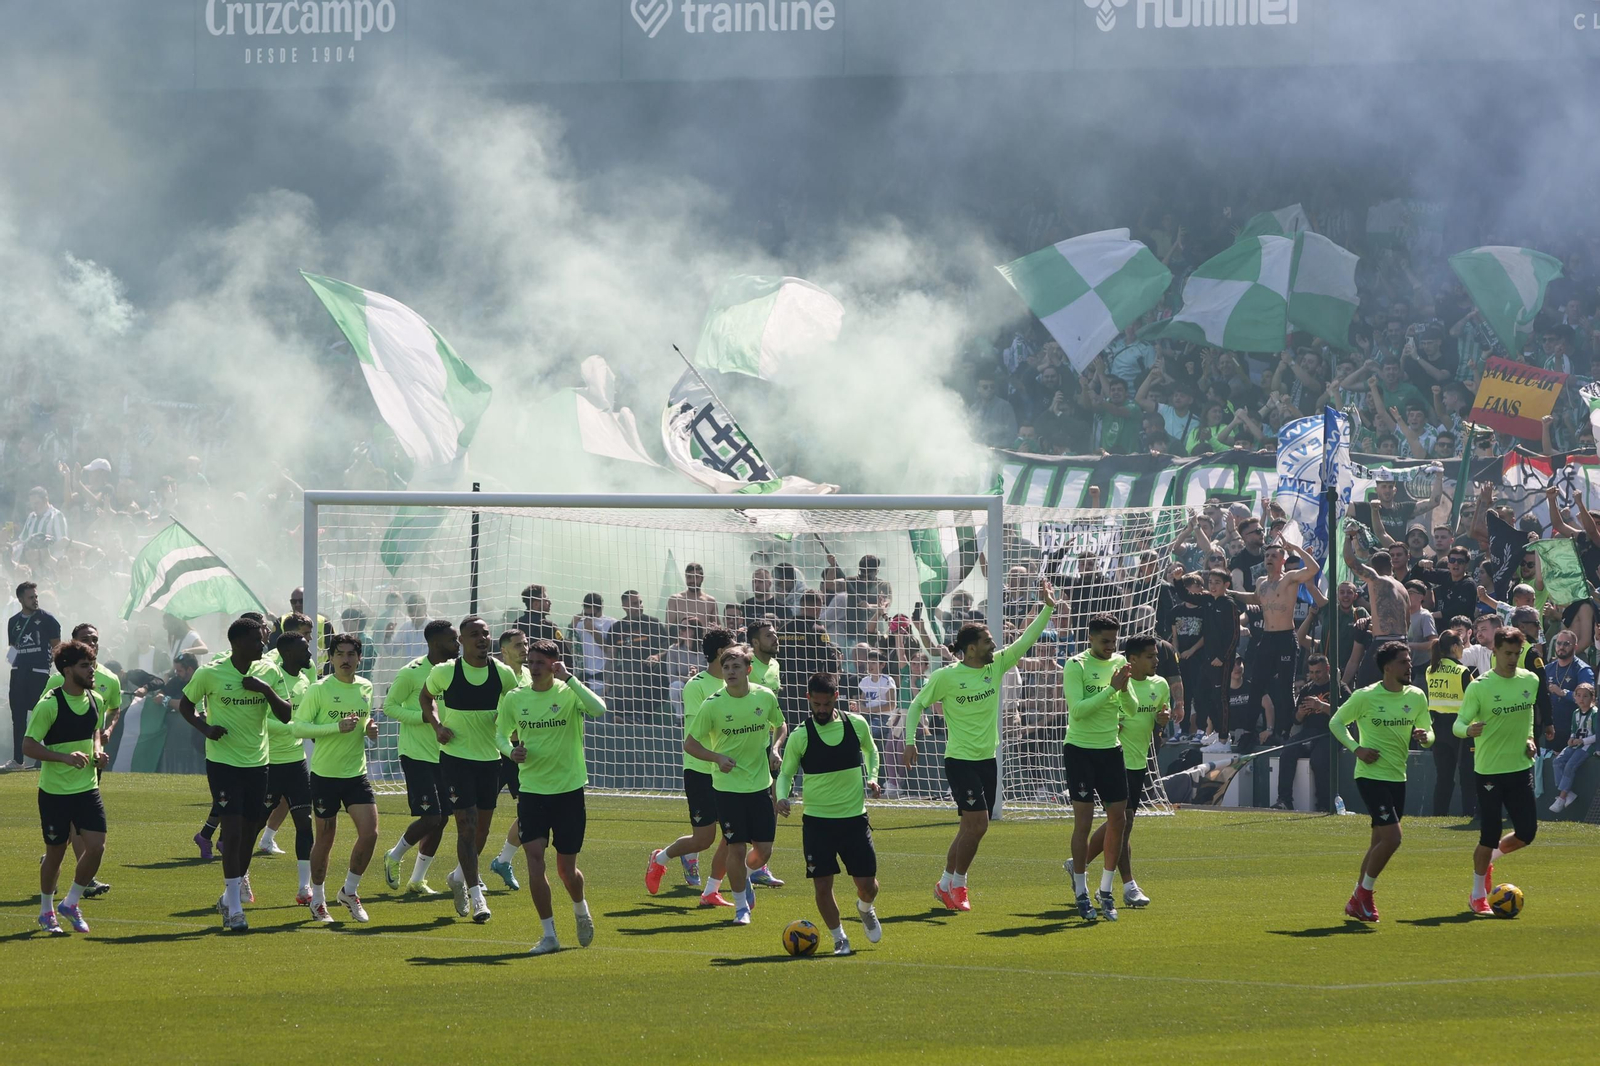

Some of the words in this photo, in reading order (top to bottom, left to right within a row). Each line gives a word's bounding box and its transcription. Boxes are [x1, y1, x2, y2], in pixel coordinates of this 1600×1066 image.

[205, 0, 396, 41] Cruzcampo
[681, 0, 836, 33] trainline
[245, 48, 297, 64] DESDE
[312, 46, 355, 63] 1904
[1482, 396, 1521, 418] FANS
[1427, 664, 1461, 675] URIDAD
[1429, 678, 1449, 689] 2571
[1137, 705, 1157, 713] ainlin
[528, 717, 567, 729] trainline
[732, 723, 765, 735] trainline
